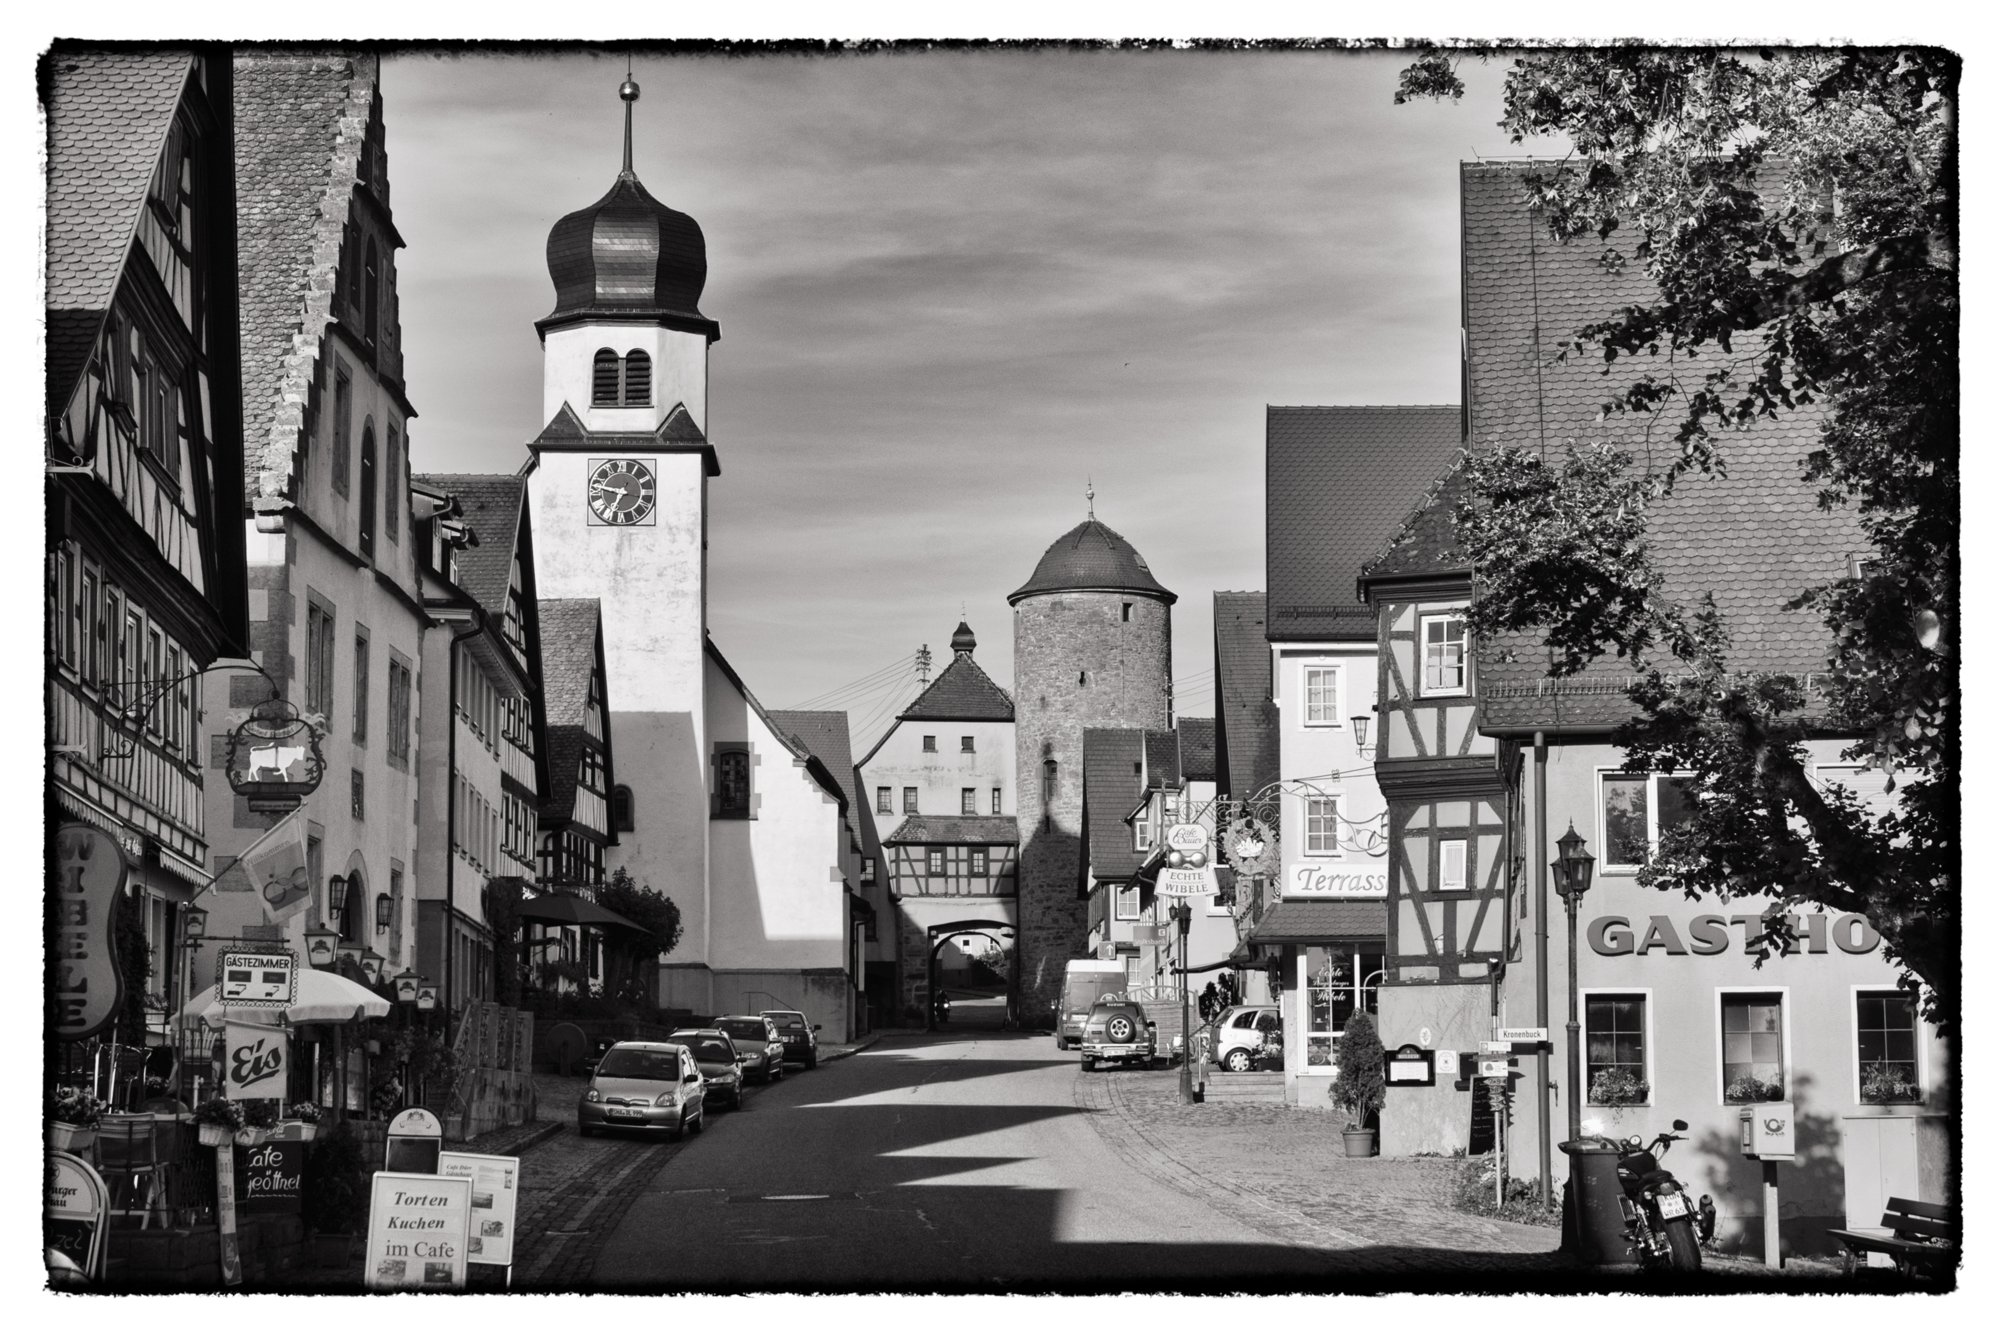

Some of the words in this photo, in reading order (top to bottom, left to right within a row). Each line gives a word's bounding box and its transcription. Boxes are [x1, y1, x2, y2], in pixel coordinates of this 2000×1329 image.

[1170, 871, 1204, 880] ECHTE
[1297, 865, 1389, 892] Terrass
[1165, 882, 1209, 894] WIBELE
[226, 955, 290, 969] GÄSTEZIMMER
[1503, 1030, 1542, 1039] Kronenbuck
[231, 1038, 282, 1084] Eis
[394, 1191, 449, 1207] Torten
[387, 1216, 445, 1230] Kuchen
[385, 1239, 408, 1257] im
[414, 1241, 455, 1258] Cafe
